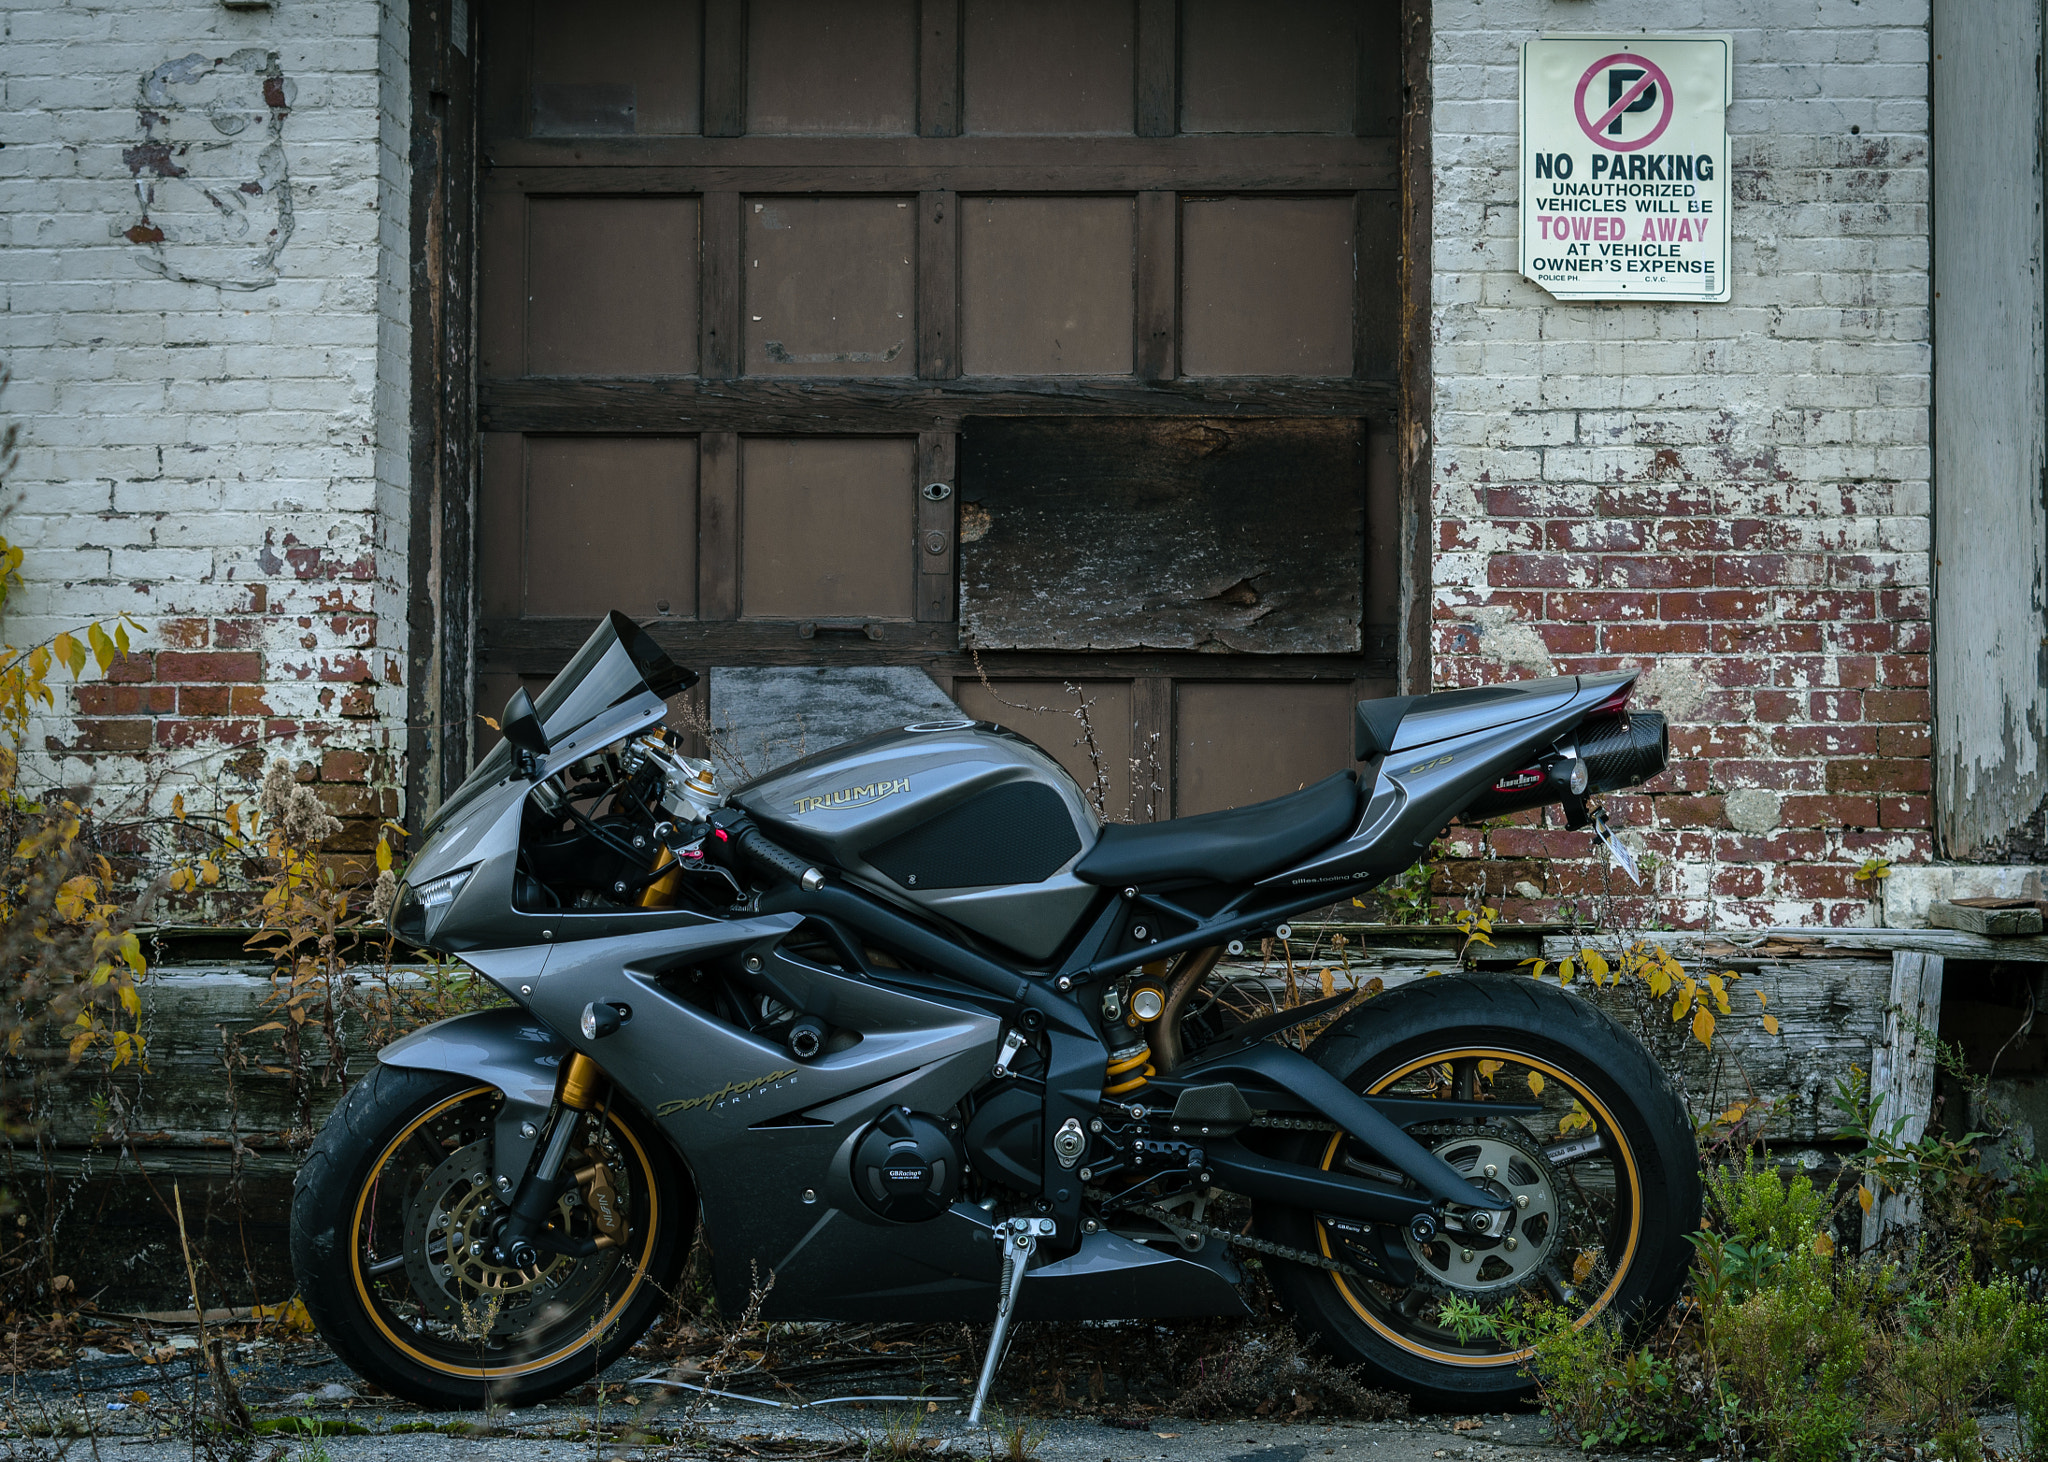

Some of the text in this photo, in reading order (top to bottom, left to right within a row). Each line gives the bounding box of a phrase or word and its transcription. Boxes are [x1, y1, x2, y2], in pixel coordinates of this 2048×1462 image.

[1535, 152, 1714, 181] NO PARKING
[1552, 183, 1696, 197] UNAUTHORIZED
[1536, 198, 1713, 213] VEHICLES WILL BE
[1537, 215, 1709, 242] TOWED AWAY
[1567, 243, 1681, 257] AT VEHICLE
[1532, 258, 1715, 274] OWNER'S EXPENSE
[1409, 754, 1455, 774] 675
[793, 778, 911, 815] TRIUMPH
[655, 1068, 798, 1117] Daytona
[717, 1076, 798, 1108] TRIPLE
[596, 1193, 615, 1228] NISSIN
